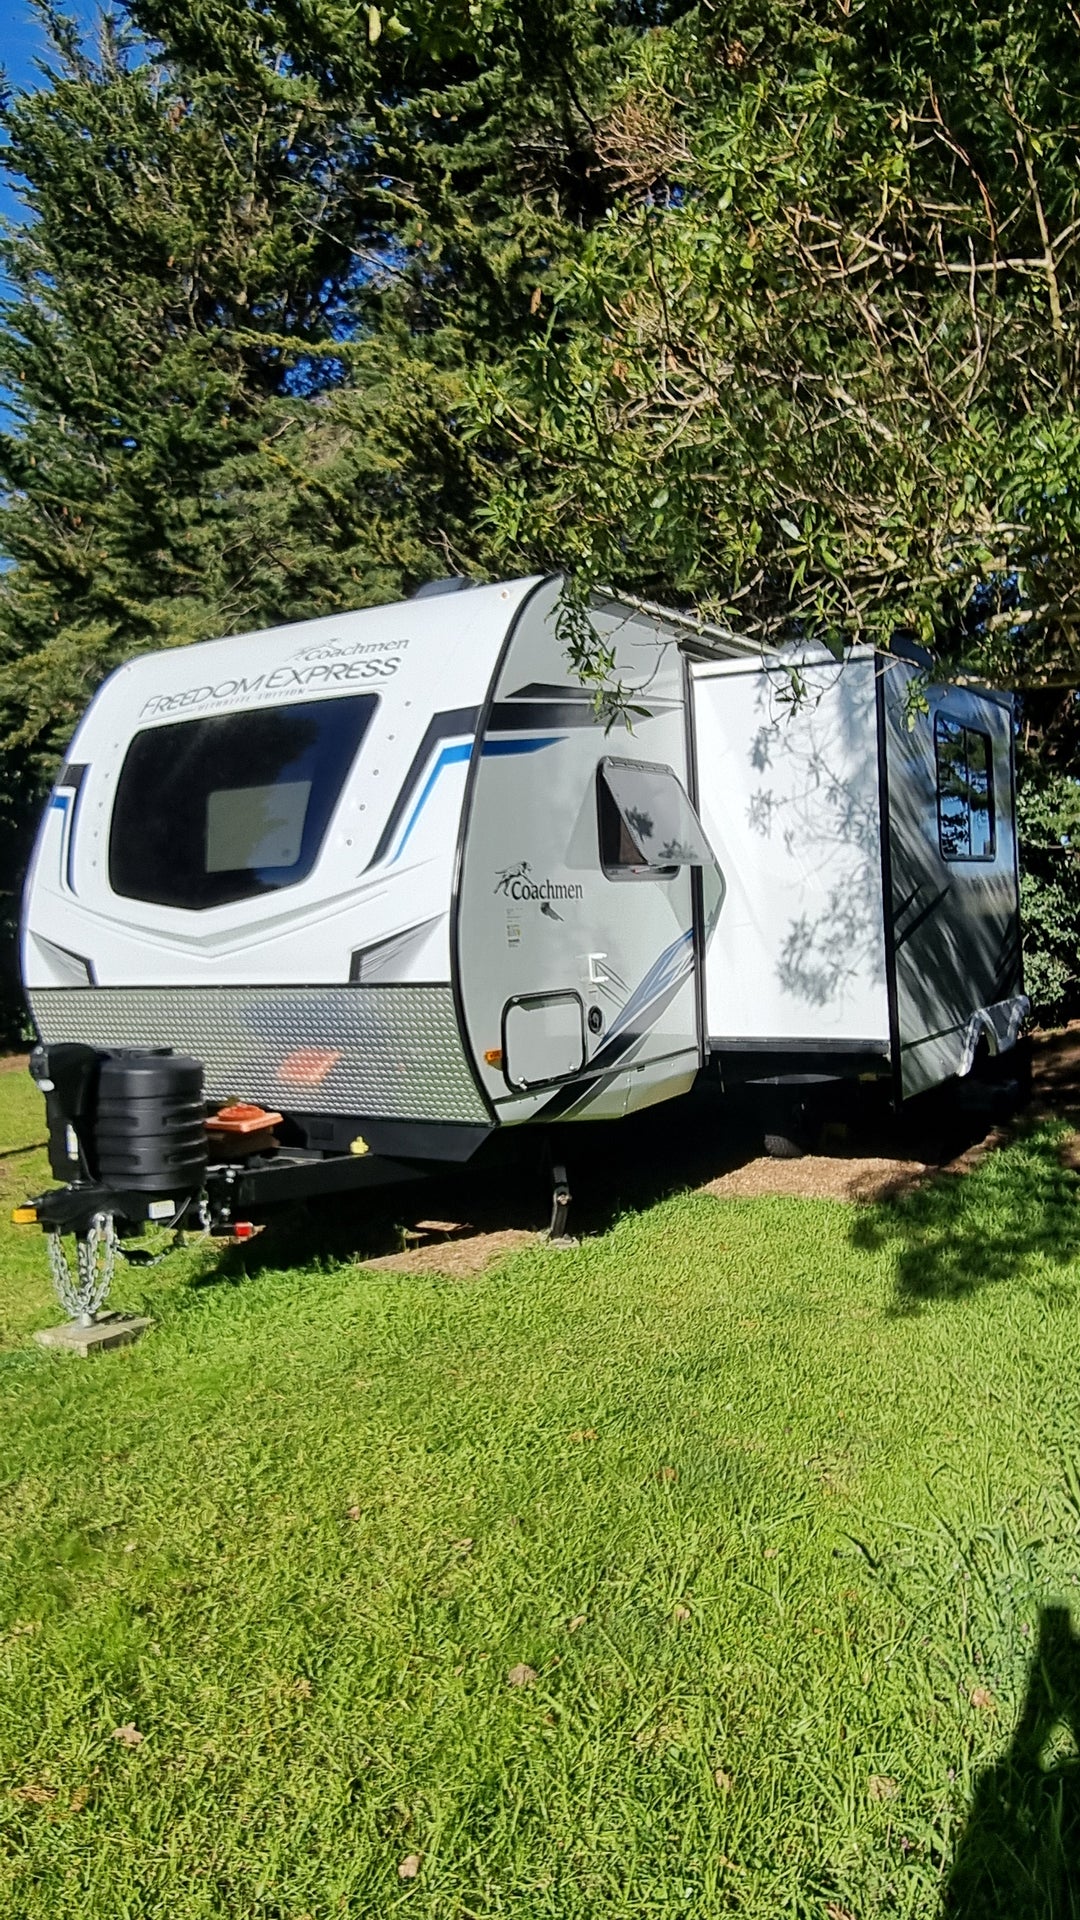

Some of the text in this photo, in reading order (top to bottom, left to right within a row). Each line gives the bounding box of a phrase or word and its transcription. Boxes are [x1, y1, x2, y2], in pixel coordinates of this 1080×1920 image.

[304, 639, 410, 661] Coachmen
[138, 656, 402, 718] FREEDOM EXPRESS
[511, 879, 583, 900] Coachmen
